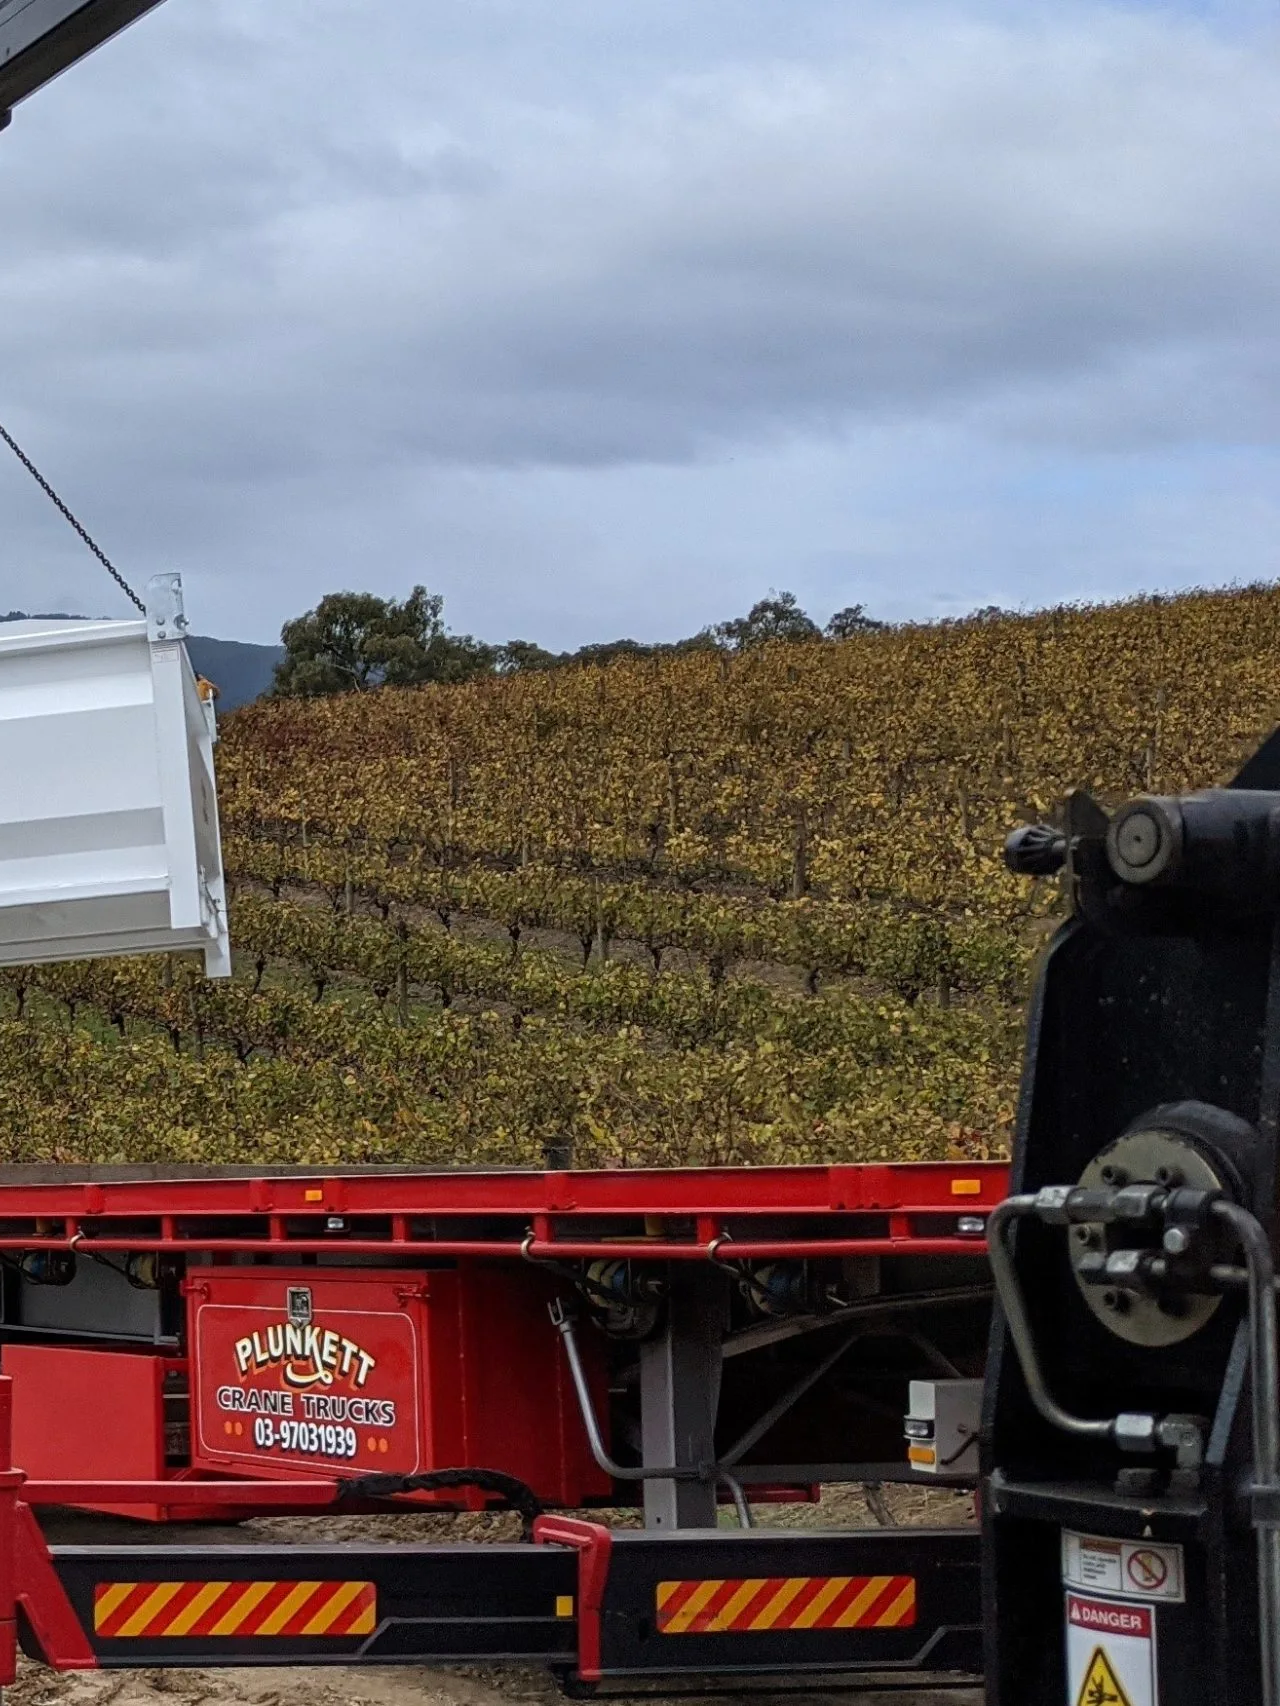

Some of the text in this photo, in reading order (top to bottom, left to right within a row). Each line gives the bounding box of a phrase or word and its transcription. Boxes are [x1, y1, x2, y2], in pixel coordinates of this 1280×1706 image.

[234, 1322, 376, 1387] PLUNKETT
[217, 1386, 396, 1427] CRANE TRUCKS
[254, 1417, 357, 1458] 03-97031939
[1082, 1607, 1142, 1630] DANGER
